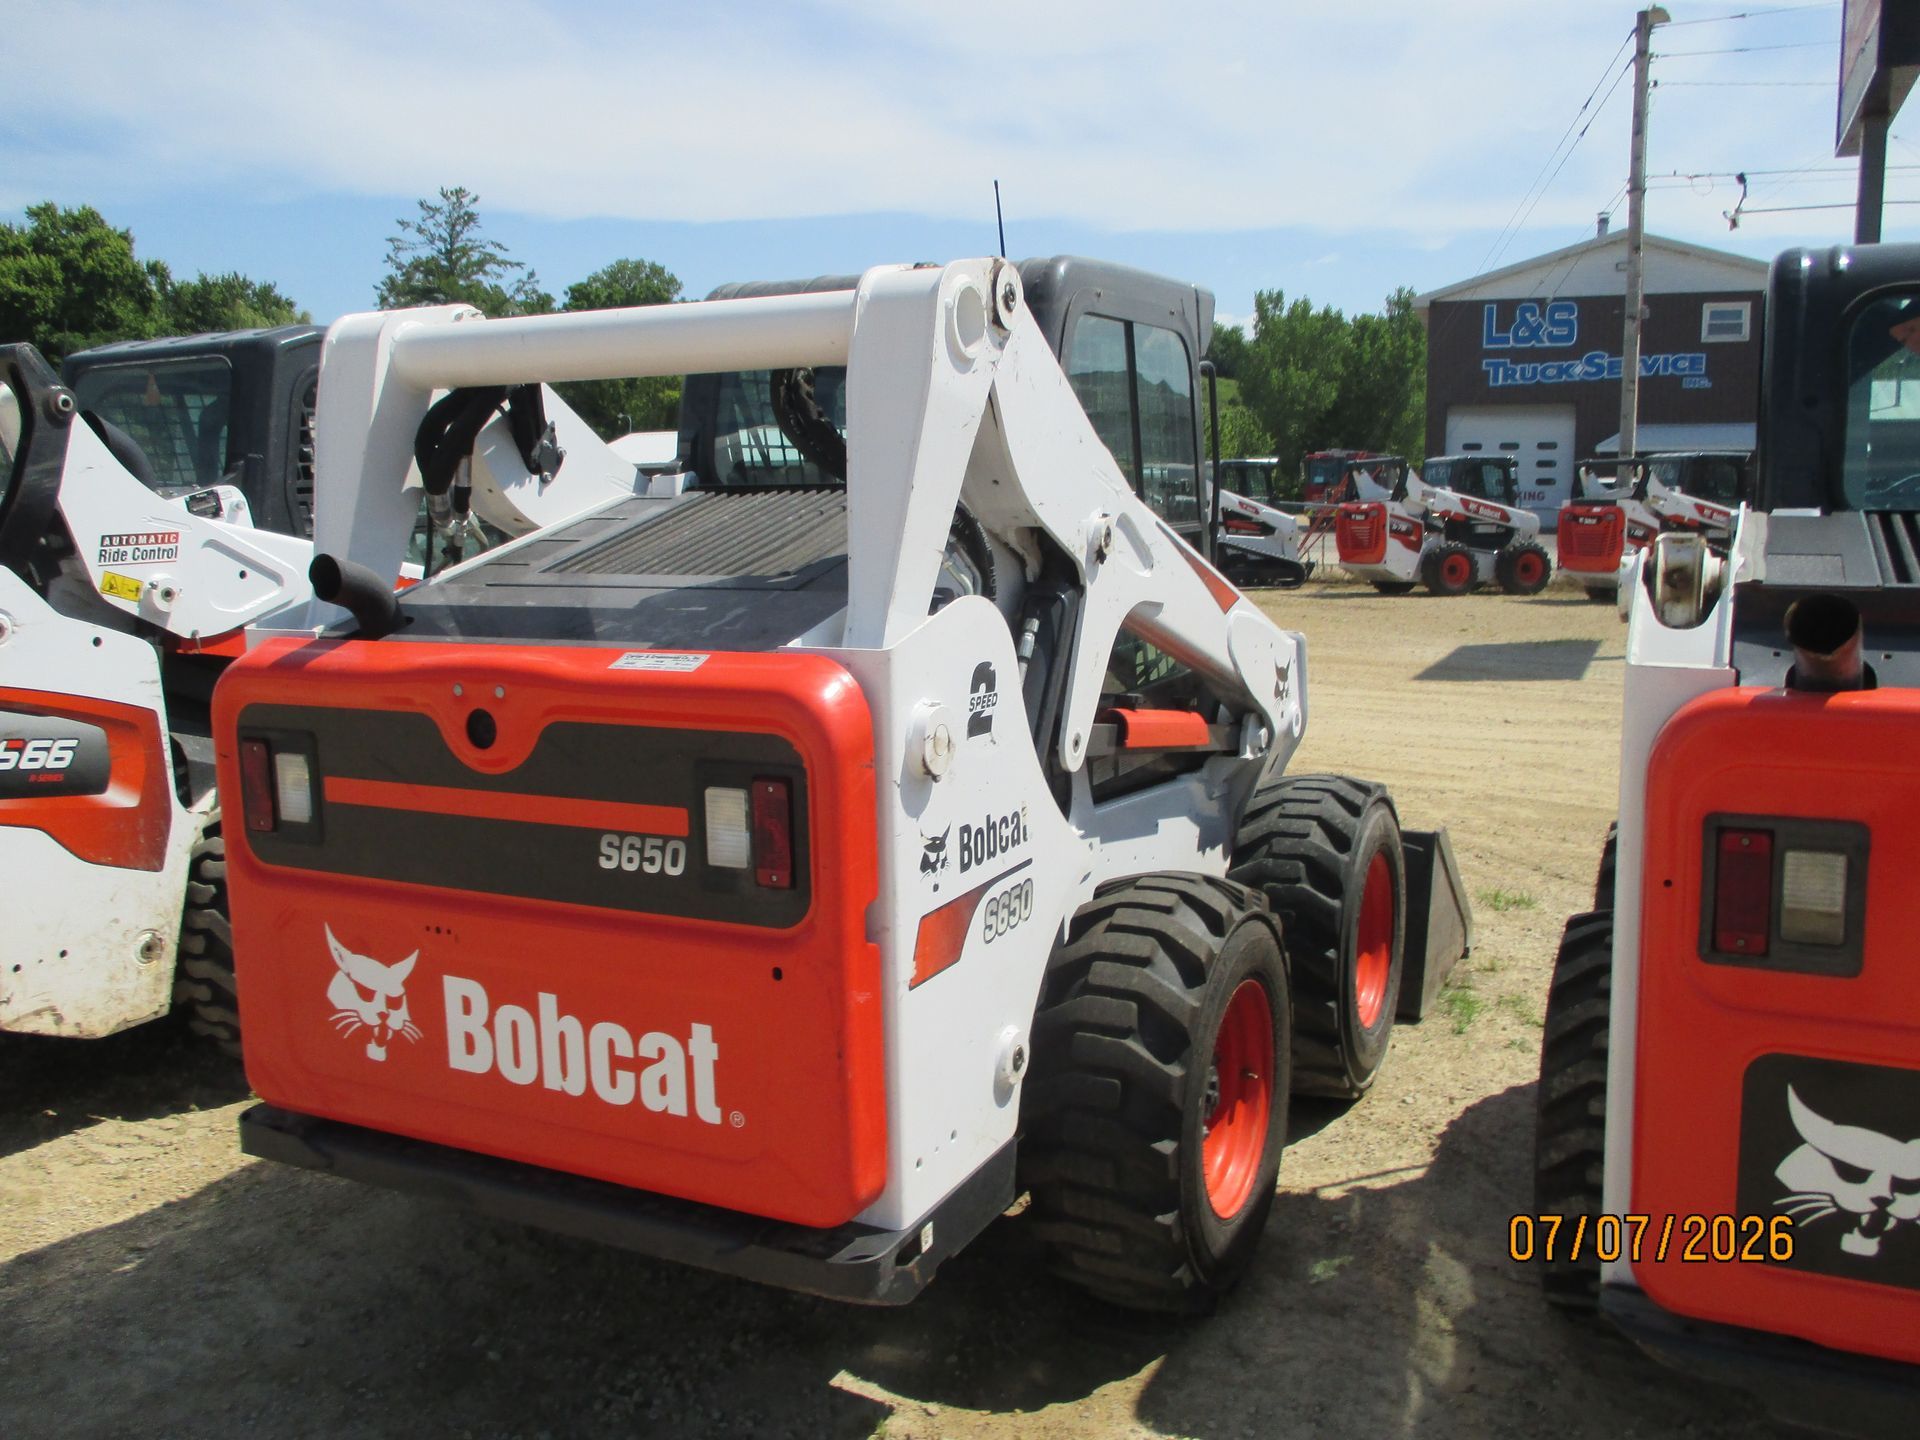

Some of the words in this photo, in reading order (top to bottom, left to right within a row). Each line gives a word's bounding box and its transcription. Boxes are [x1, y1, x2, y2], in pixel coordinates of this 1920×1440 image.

[1483, 302, 1578, 348] L&S
[1581, 351, 1706, 379] SEVICE
[98, 548, 128, 563] Ride
[132, 545, 178, 561] Control
[103, 534, 177, 546] AUTOMATIC
[969, 692, 998, 713] SPEED
[598, 834, 686, 876] S650
[983, 877, 1034, 945] S650
[443, 974, 722, 1125] Bobcat
